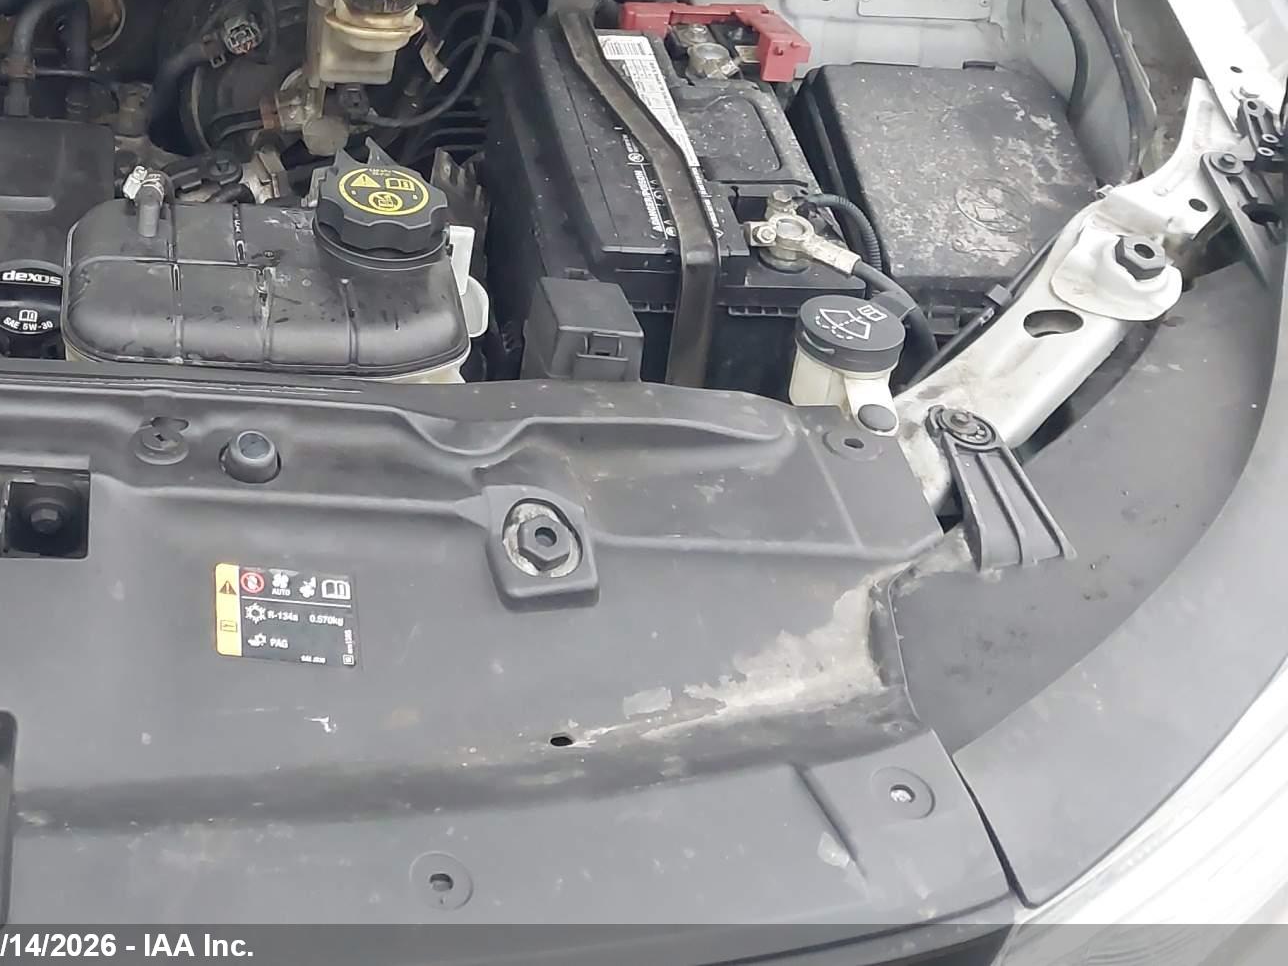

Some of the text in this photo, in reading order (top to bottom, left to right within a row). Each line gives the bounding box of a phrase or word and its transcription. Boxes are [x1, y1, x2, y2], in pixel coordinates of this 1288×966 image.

[2, 270, 62, 286] dexos
[3, 317, 54, 331] SAE 5W-30
[271, 588, 291, 596] AUTO
[267, 611, 344, 627] R-134a 0.570kg
[269, 638, 289, 649] PAG
